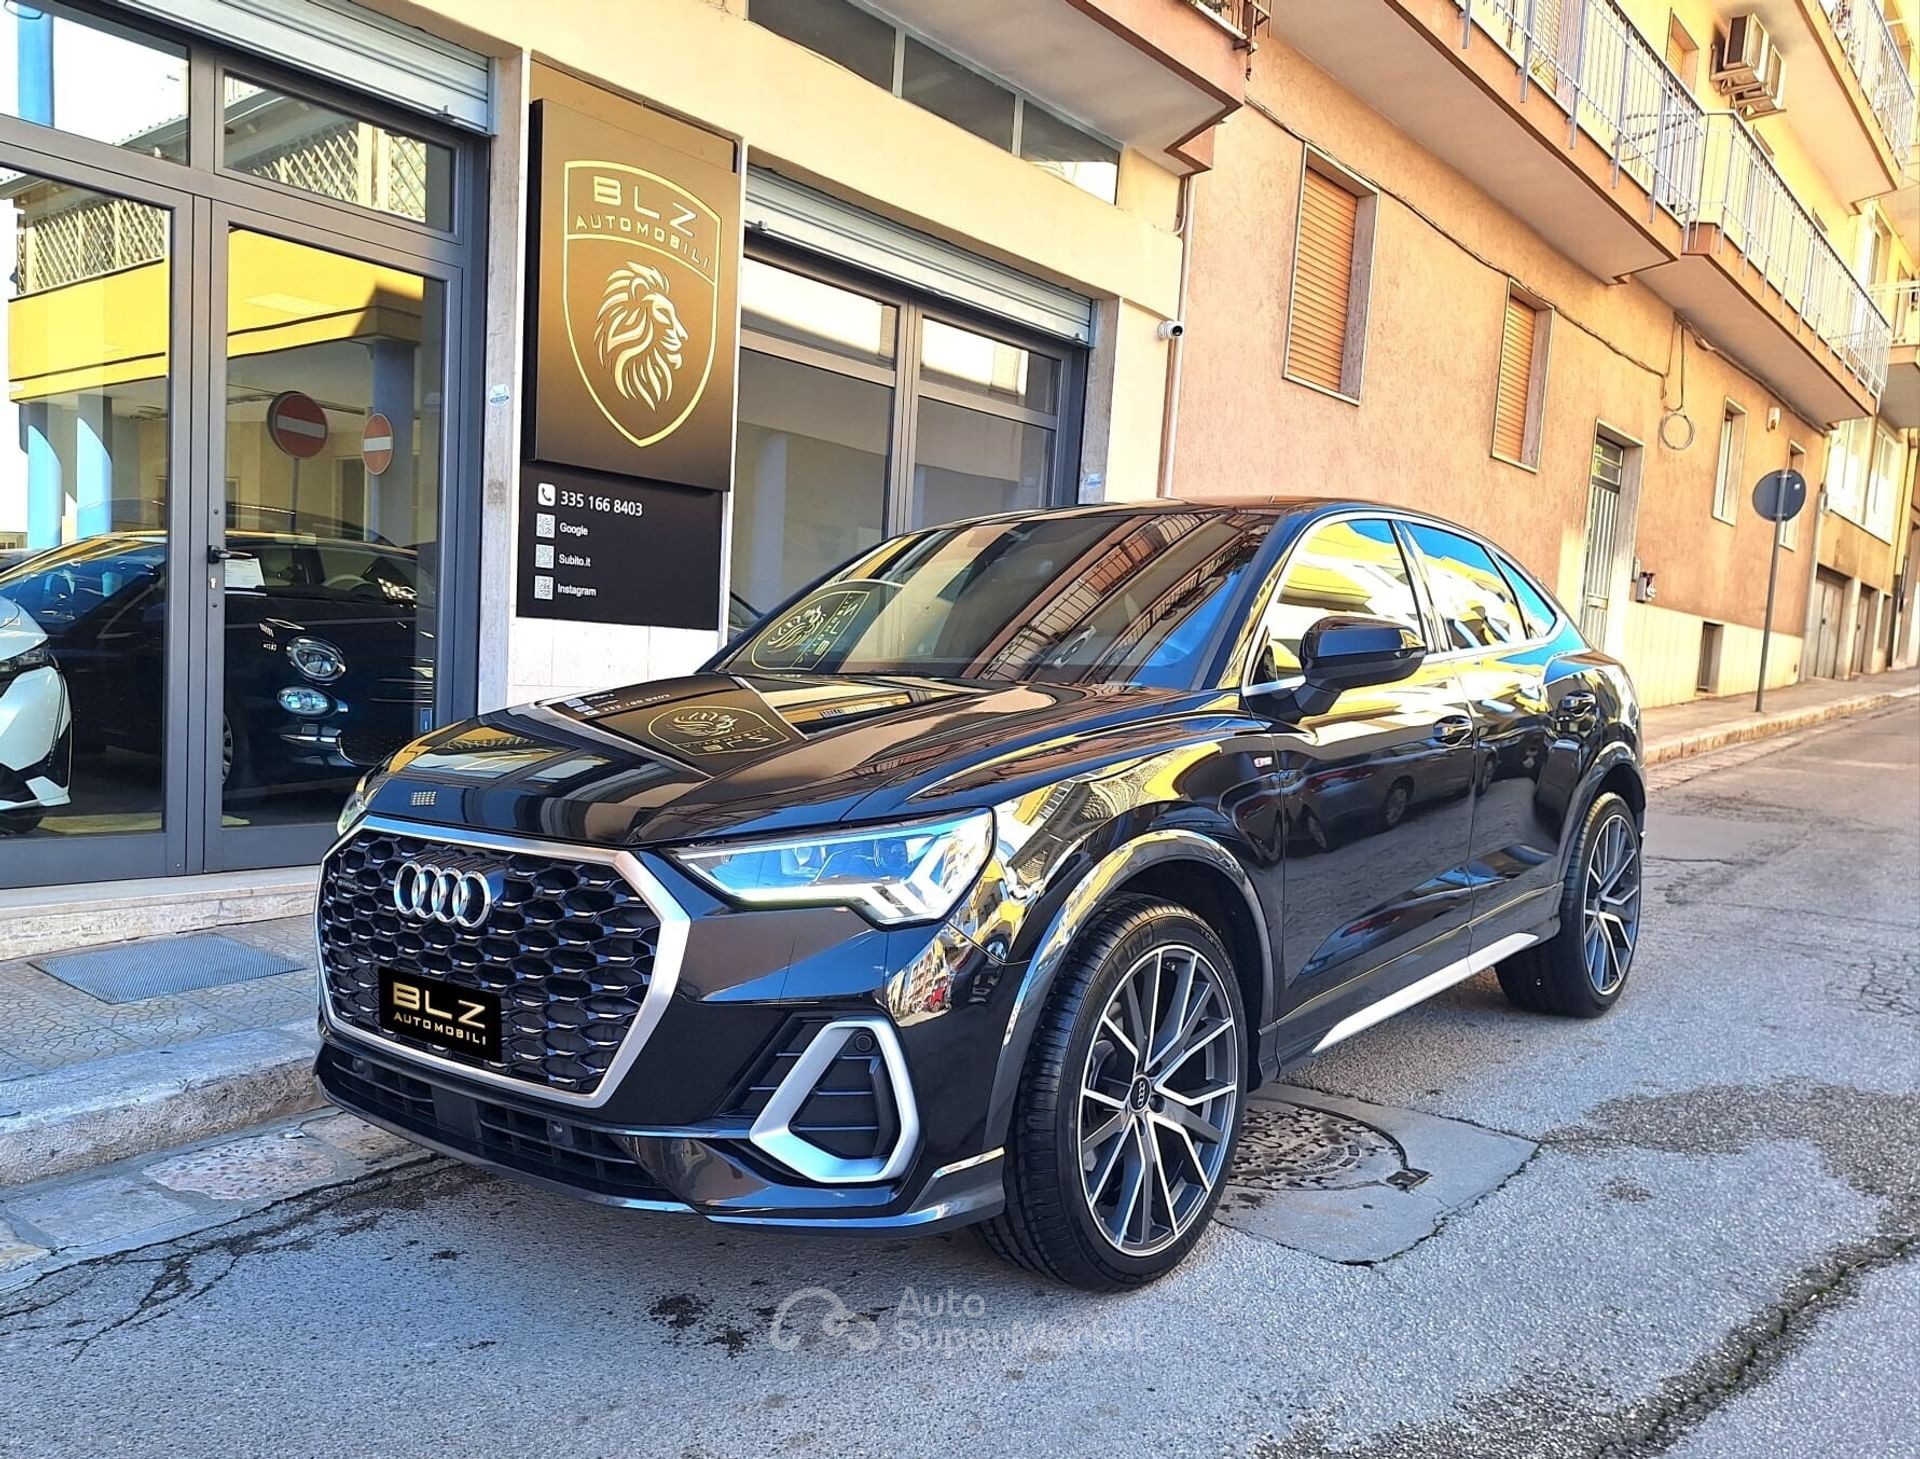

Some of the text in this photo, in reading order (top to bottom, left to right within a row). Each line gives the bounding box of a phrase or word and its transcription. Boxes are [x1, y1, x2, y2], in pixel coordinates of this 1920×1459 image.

[593, 175, 698, 237] BLZ
[575, 215, 711, 270] AUTOMOBILI
[560, 490, 643, 517] 335 166 8403
[559, 522, 589, 537] Google
[558, 554, 592, 568] Subito.it
[557, 583, 597, 598] Instagram
[393, 981, 486, 1029] BLZ
[393, 1012, 486, 1046] AUTOMOBILI
